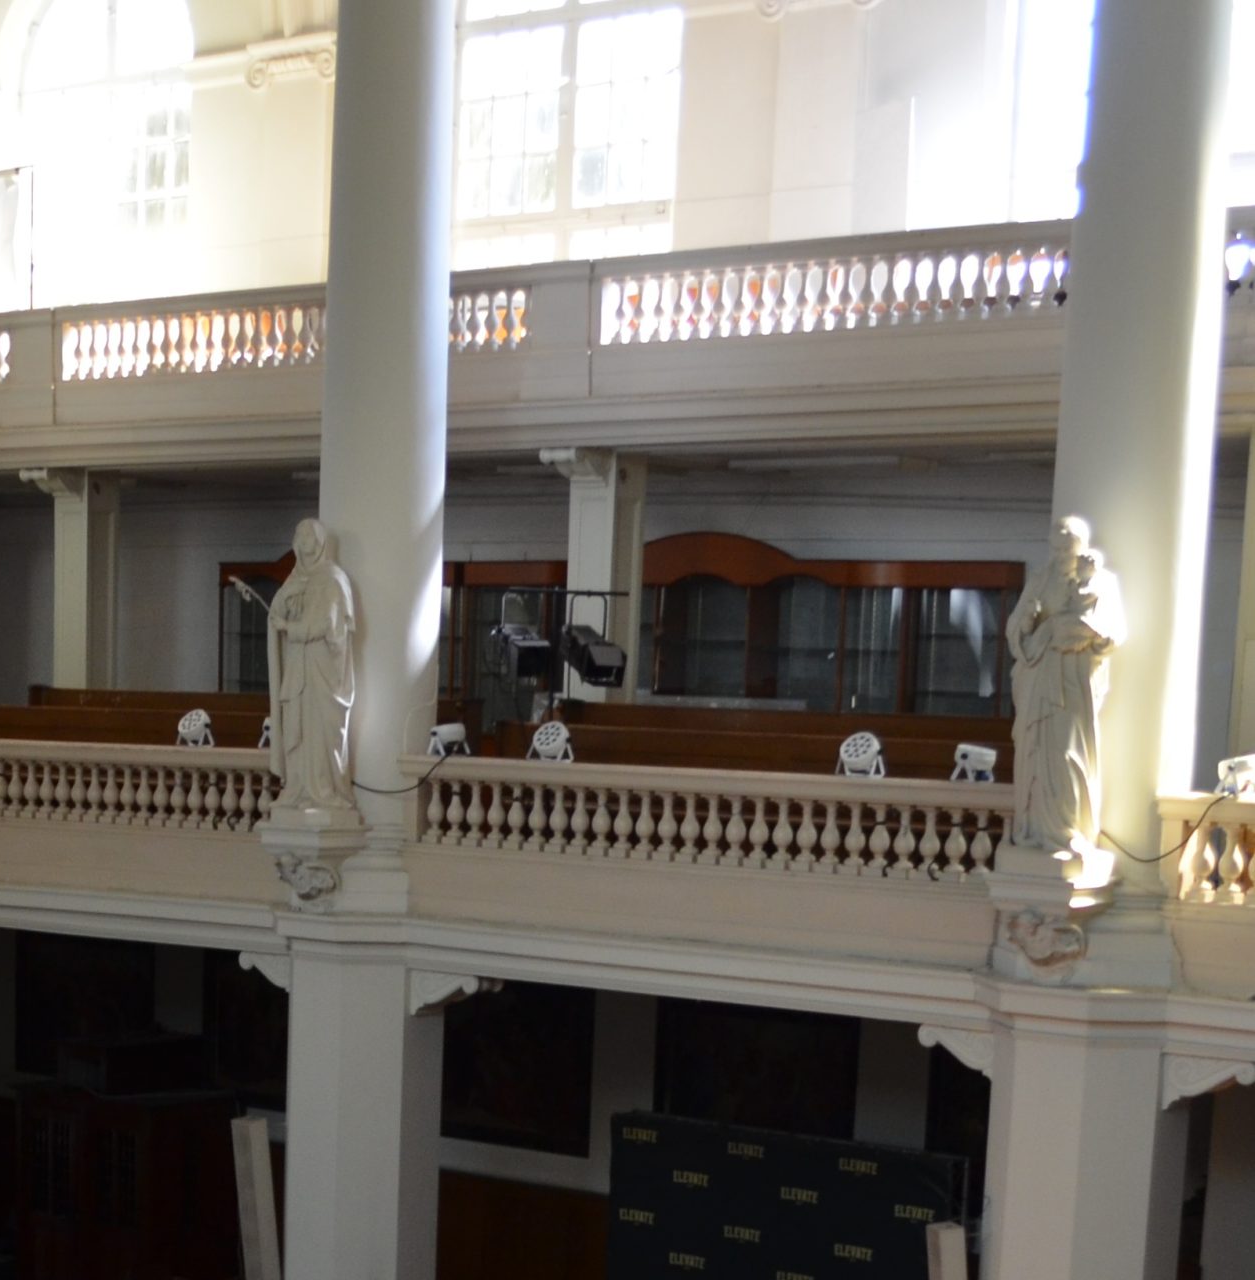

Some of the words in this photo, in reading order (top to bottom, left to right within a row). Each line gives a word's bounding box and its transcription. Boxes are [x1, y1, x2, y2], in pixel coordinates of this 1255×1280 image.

[622, 1126, 657, 1143] ELEVATE
[727, 1141, 764, 1160] ELEVATE
[838, 1157, 878, 1175] ELEVATE
[672, 1169, 709, 1187] ELEVATE
[780, 1186, 818, 1204] ELEVATE
[618, 1207, 654, 1225] ELEVATE
[894, 1204, 935, 1223] ELEVATE
[723, 1224, 761, 1242] ELEVATE
[668, 1251, 705, 1270] ELEVATE
[833, 1243, 873, 1261] ELEVATE
